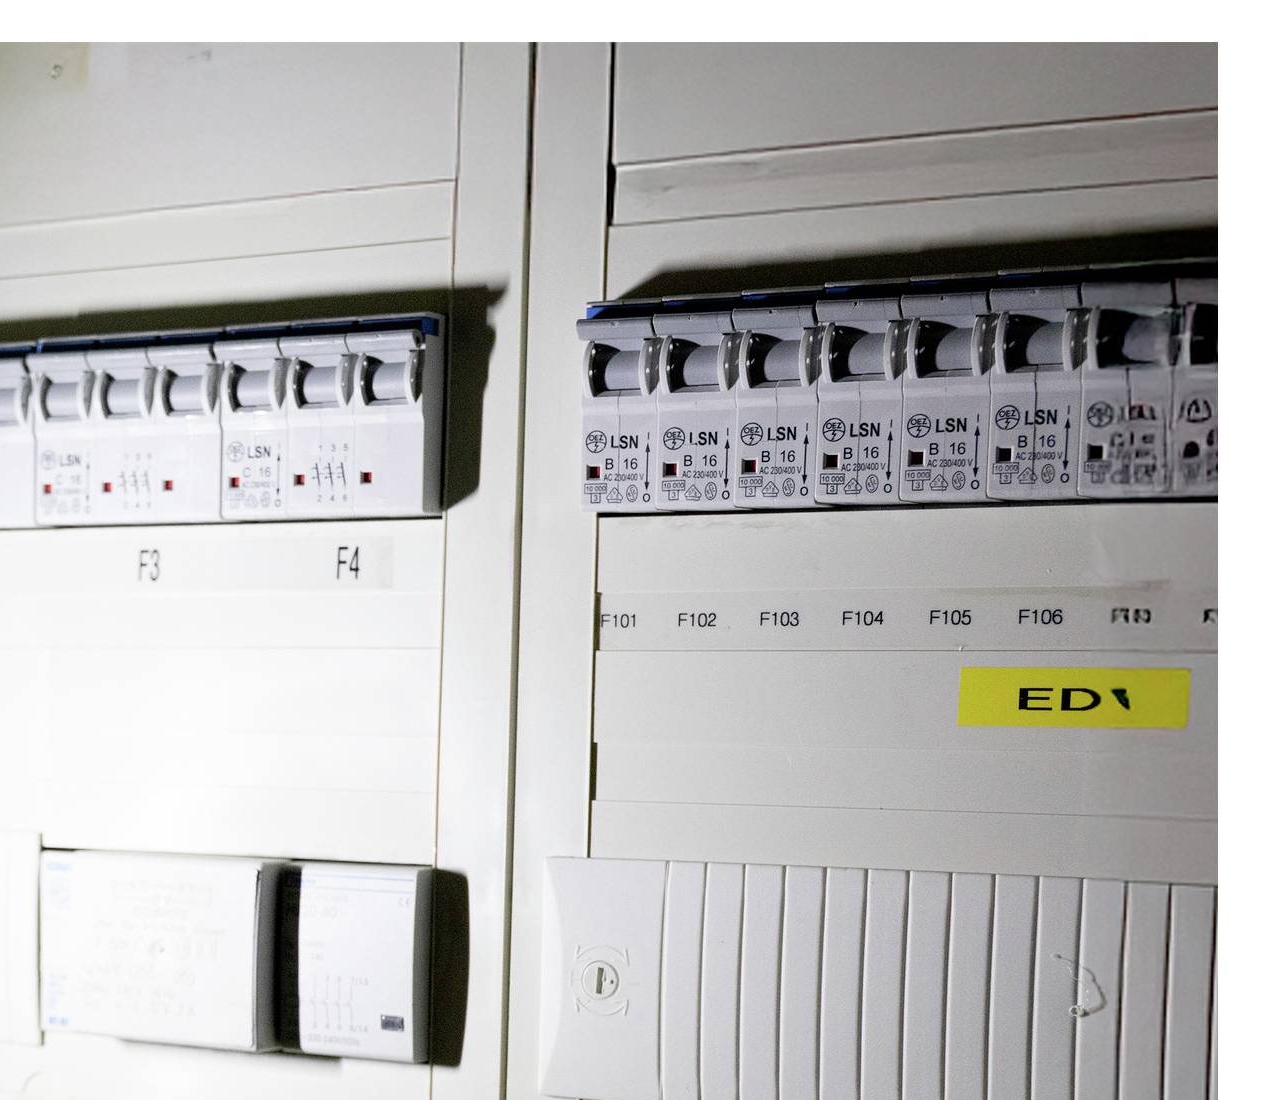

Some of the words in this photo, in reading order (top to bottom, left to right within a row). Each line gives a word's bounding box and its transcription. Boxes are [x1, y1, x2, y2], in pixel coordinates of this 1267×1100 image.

[999, 409, 1017, 417] OEZ
[1025, 409, 1058, 425] LSN
[826, 422, 842, 430] OEZ
[911, 418, 928, 426] OEZ
[935, 417, 967, 433] LSN
[743, 426, 760, 434] OEZ
[767, 426, 797, 441] LSN
[849, 422, 881, 438] LSN
[611, 434, 639, 450] LSN
[689, 431, 718, 446] LSN
[1017, 435, 1028, 448] B
[1039, 434, 1056, 448] 16
[247, 446, 271, 458] LSN
[761, 450, 771, 463] B
[780, 450, 796, 462] 16
[843, 447, 853, 460] B
[863, 446, 879, 459] 16
[929, 442, 939, 456] B
[949, 442, 966, 455] 16
[605, 458, 613, 470] B
[623, 458, 638, 470] 16
[683, 454, 693, 467] B
[702, 454, 717, 467] 16
[139, 548, 161, 582] F3
[336, 546, 360, 580] F4
[600, 613, 637, 628] F101
[677, 612, 717, 628] F102
[759, 611, 800, 626] F103
[842, 610, 884, 626] F104
[929, 609, 972, 624] F105
[1018, 609, 1063, 624] F106
